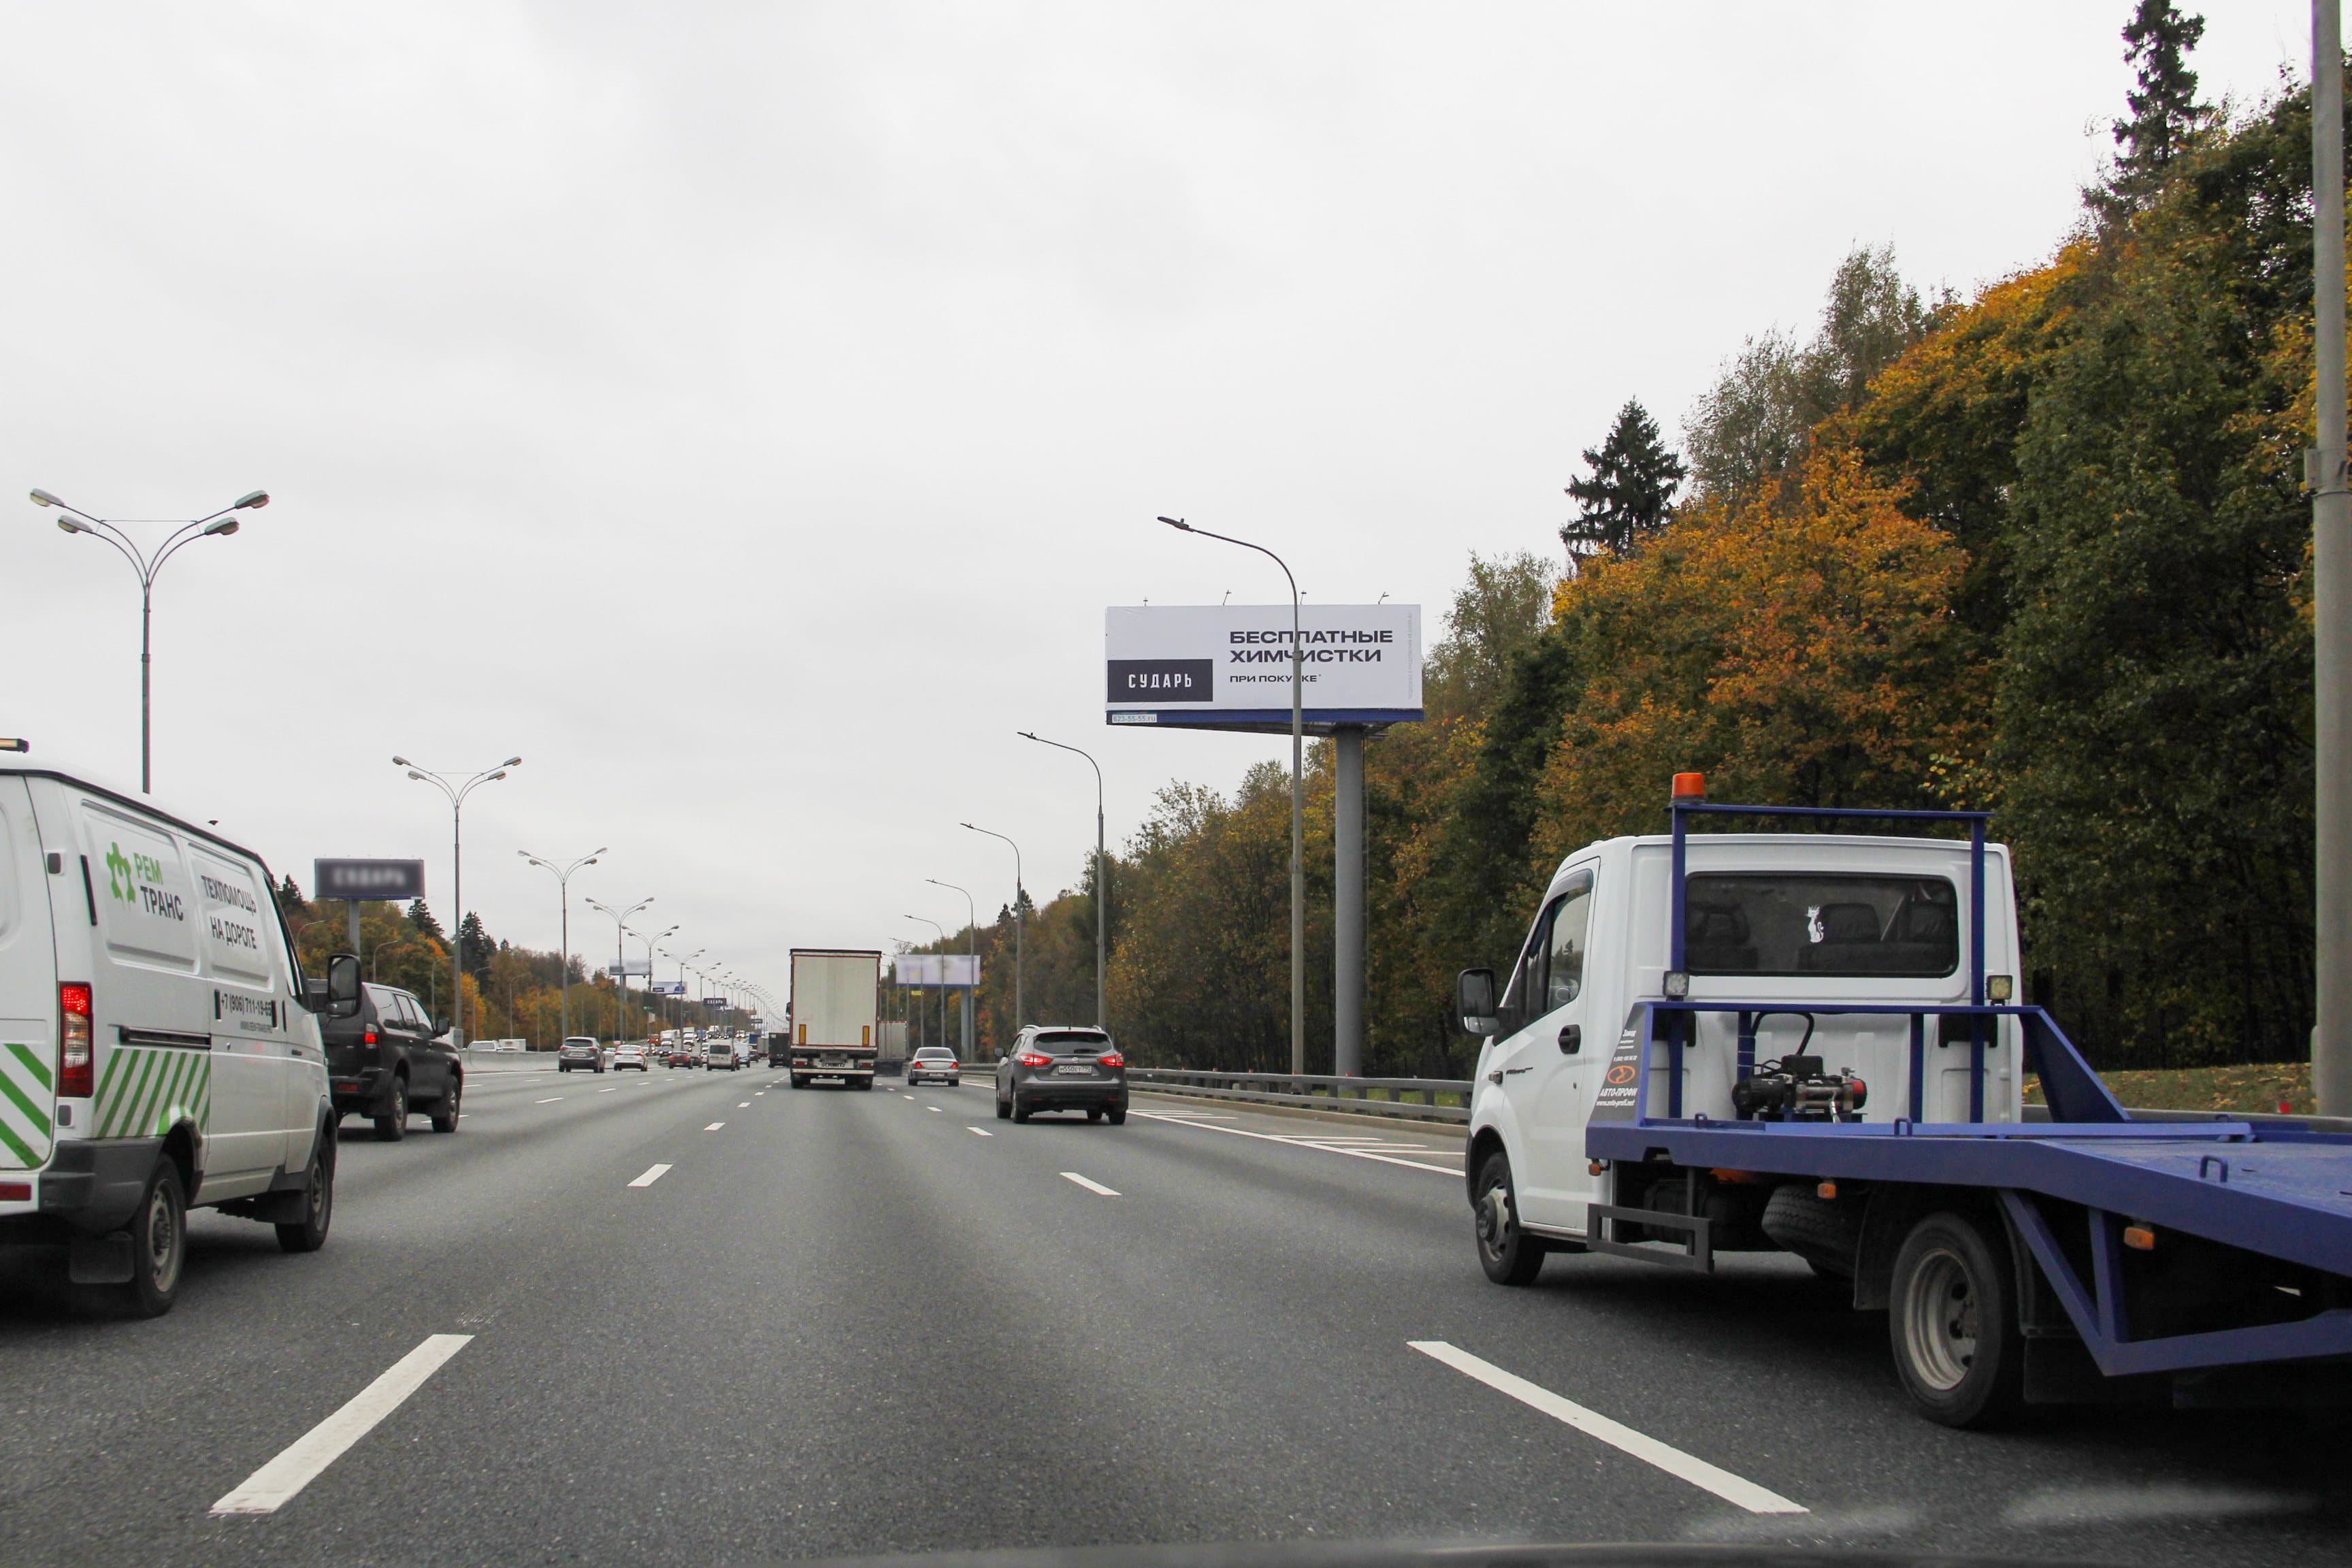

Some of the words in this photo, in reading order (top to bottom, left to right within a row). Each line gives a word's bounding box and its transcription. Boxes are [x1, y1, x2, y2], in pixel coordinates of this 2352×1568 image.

[1230, 630, 1392, 644] БЕСПЛАТНЫЕ
[1230, 649, 1381, 663] ХИМЧИСТКИ
[1128, 674, 1192, 688] СУДАРЬ
[1259, 674, 1321, 683] ПОКУКЕ
[133, 853, 163, 885] РЕМ
[201, 875, 257, 916] ТЕХПОМОЩЬ
[140, 885, 184, 921] ТРАНС
[210, 916, 225, 941] НА
[225, 921, 257, 949] ДОРОГЕ
[221, 994, 228, 1009] +7
[1599, 1088, 1638, 1097] АВТО-ПРОФИ
